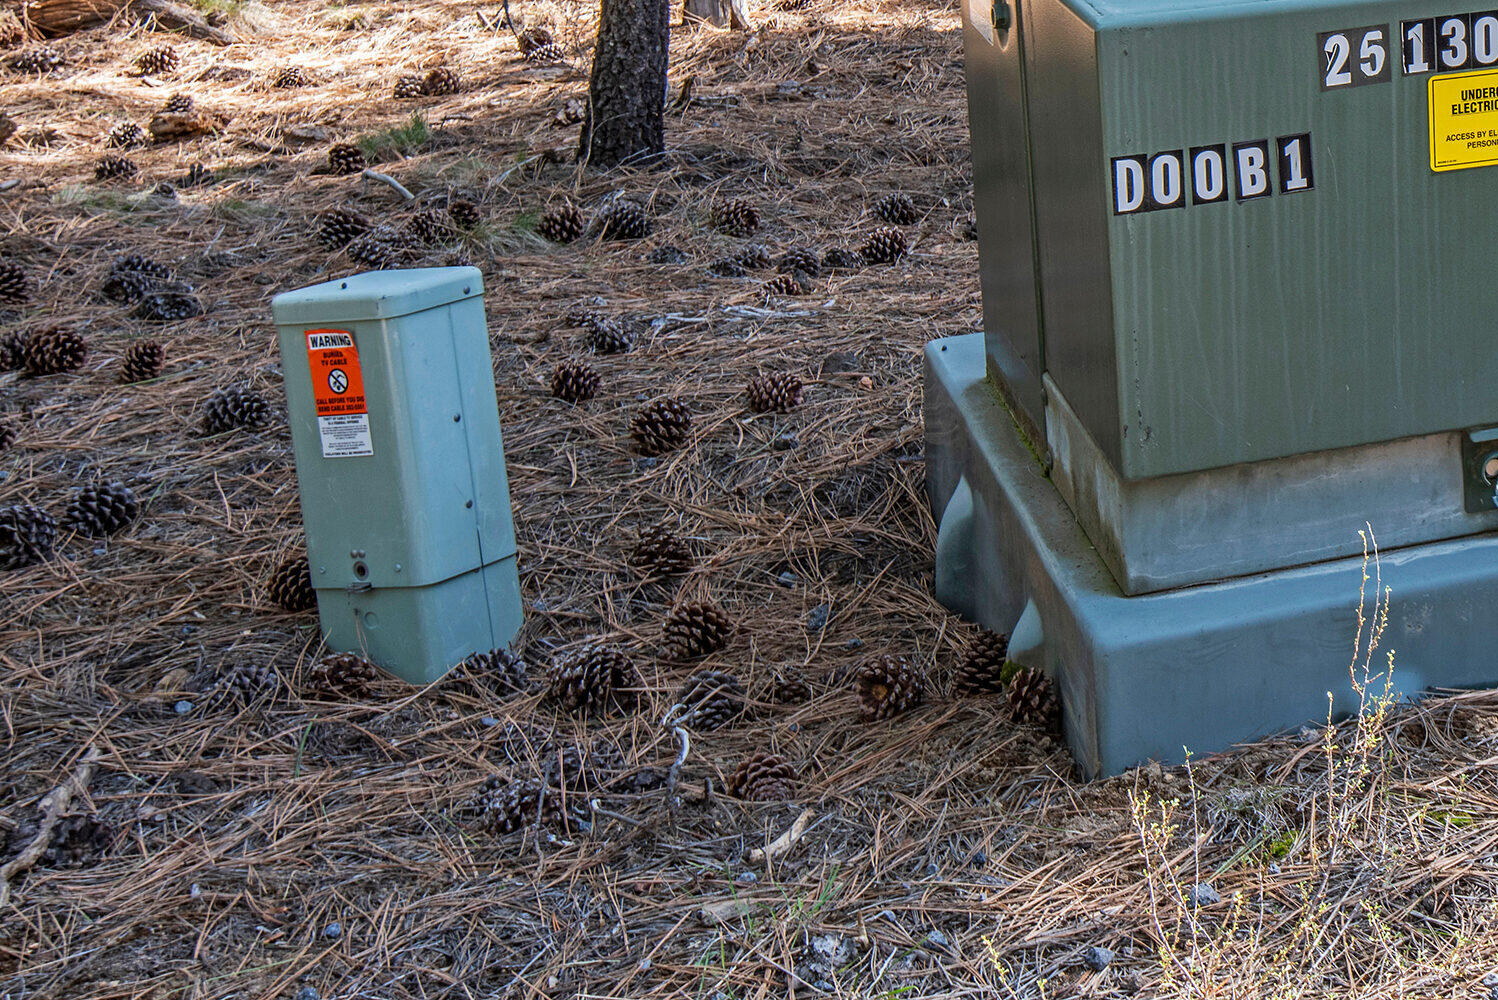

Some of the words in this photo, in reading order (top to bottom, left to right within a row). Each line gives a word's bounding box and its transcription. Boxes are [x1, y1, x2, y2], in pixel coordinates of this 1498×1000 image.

[1324, 30, 1386, 87] 25
[1446, 131, 1475, 142] ACCESS
[1477, 130, 1487, 138] BY
[310, 335, 351, 348] WARNING
